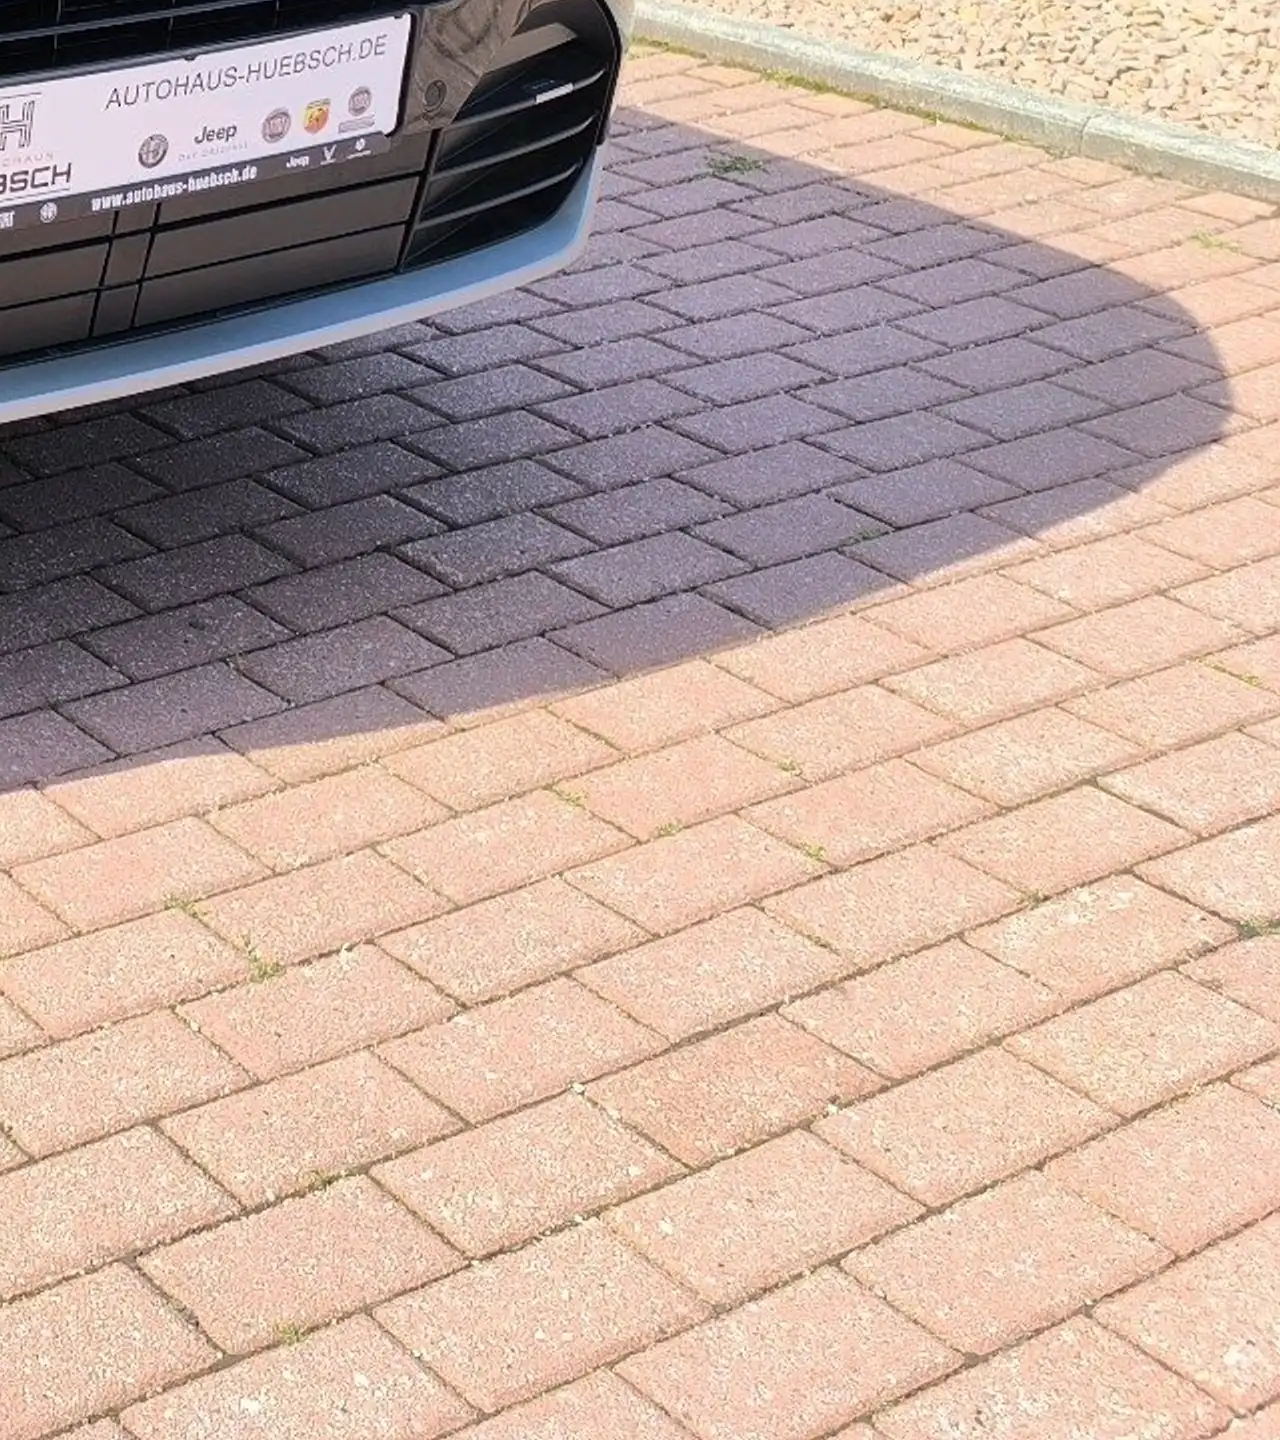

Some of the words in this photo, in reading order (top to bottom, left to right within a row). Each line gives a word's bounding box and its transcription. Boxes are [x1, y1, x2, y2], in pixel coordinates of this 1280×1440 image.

[105, 34, 388, 111] AUTOHAUS-HUEBSCH.DE
[194, 123, 238, 145] Jeep
[91, 164, 258, 212] www.autohaus-huebsch.de
